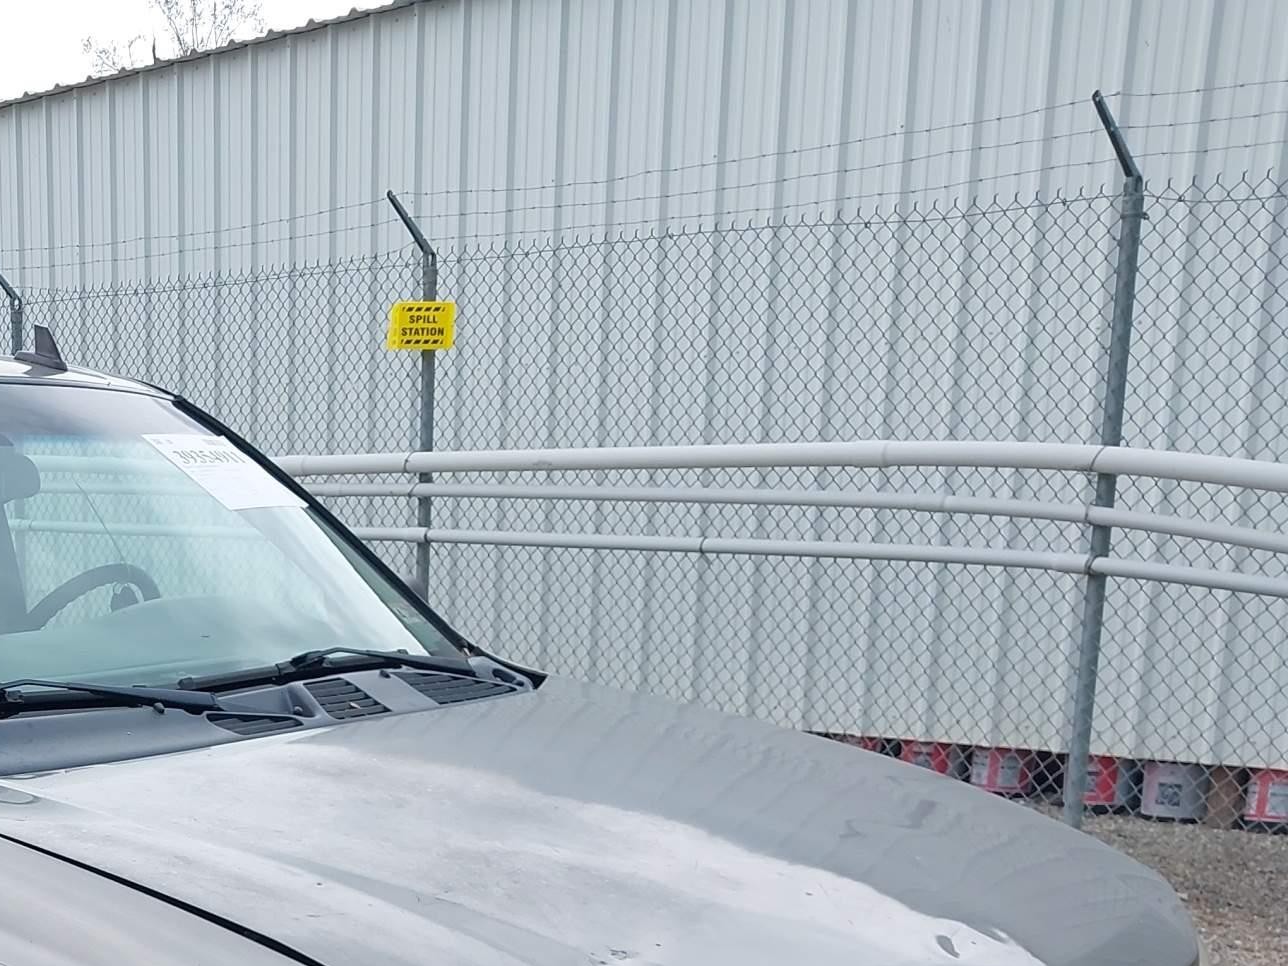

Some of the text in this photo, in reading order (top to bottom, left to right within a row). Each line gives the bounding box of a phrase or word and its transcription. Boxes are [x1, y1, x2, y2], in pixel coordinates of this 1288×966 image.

[409, 315, 438, 324] SPILL
[401, 327, 444, 336] STATION
[172, 450, 246, 465] 39354911
